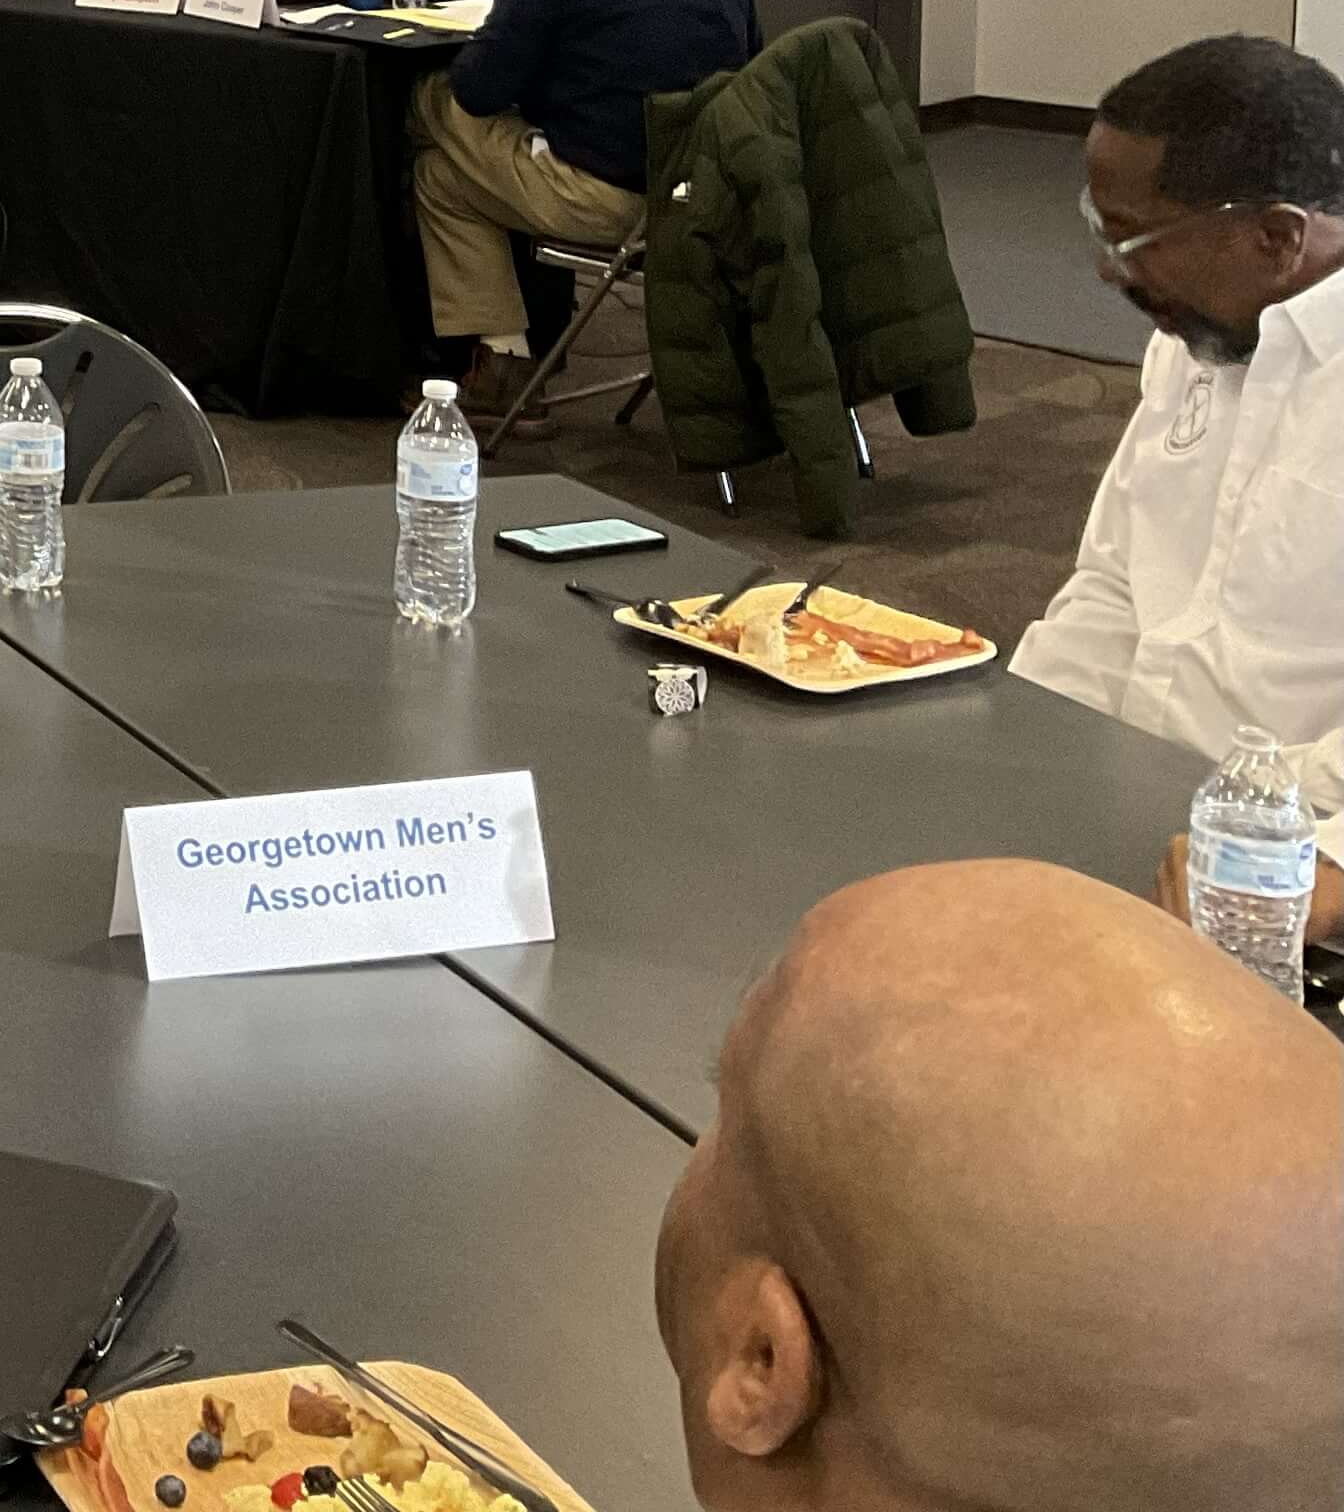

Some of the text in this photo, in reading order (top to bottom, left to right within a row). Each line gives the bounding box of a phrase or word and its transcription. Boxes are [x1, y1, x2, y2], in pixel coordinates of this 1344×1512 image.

[176, 812, 498, 868] Georgetown Men’s
[243, 871, 449, 915] Association
